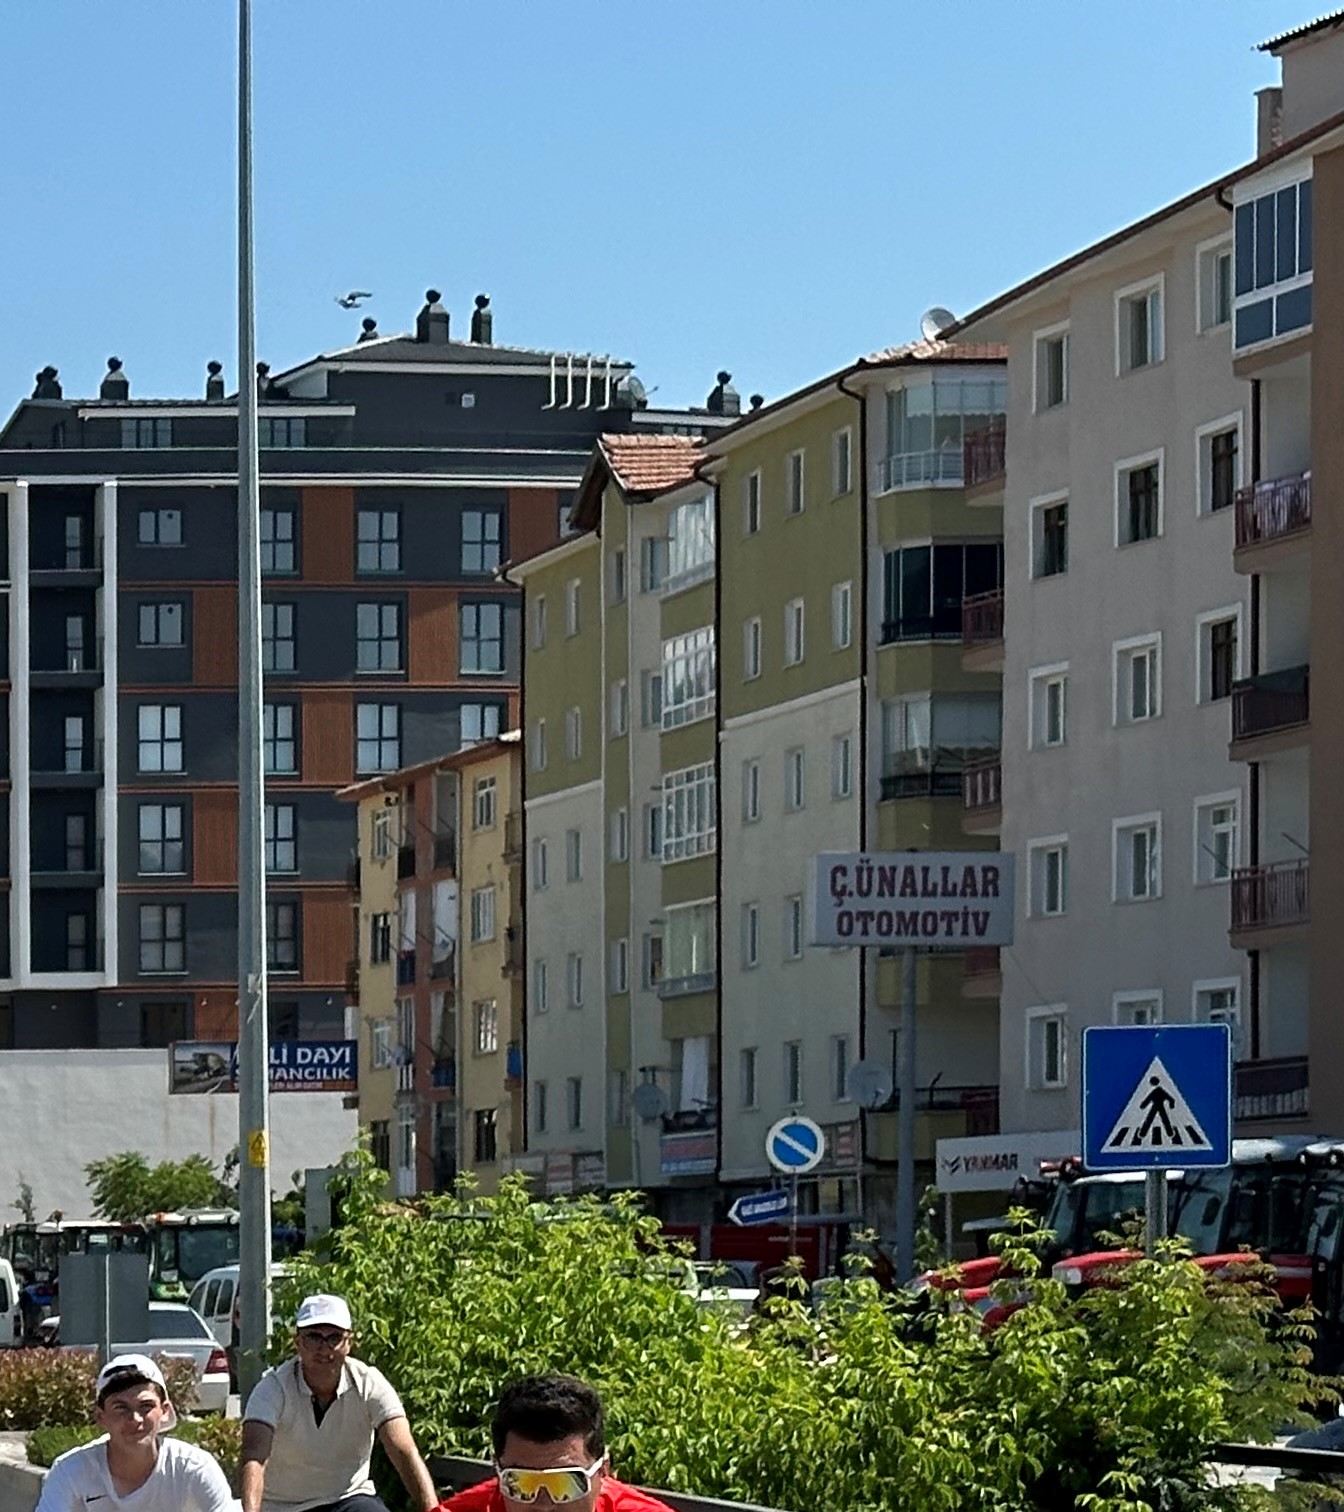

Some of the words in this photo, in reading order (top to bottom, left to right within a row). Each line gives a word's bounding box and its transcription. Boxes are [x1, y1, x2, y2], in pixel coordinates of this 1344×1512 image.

[830, 858, 1000, 907] Ç.ÜNALLAR
[837, 906, 991, 937] OTOMOTİV
[296, 1046, 351, 1065] DAYI
